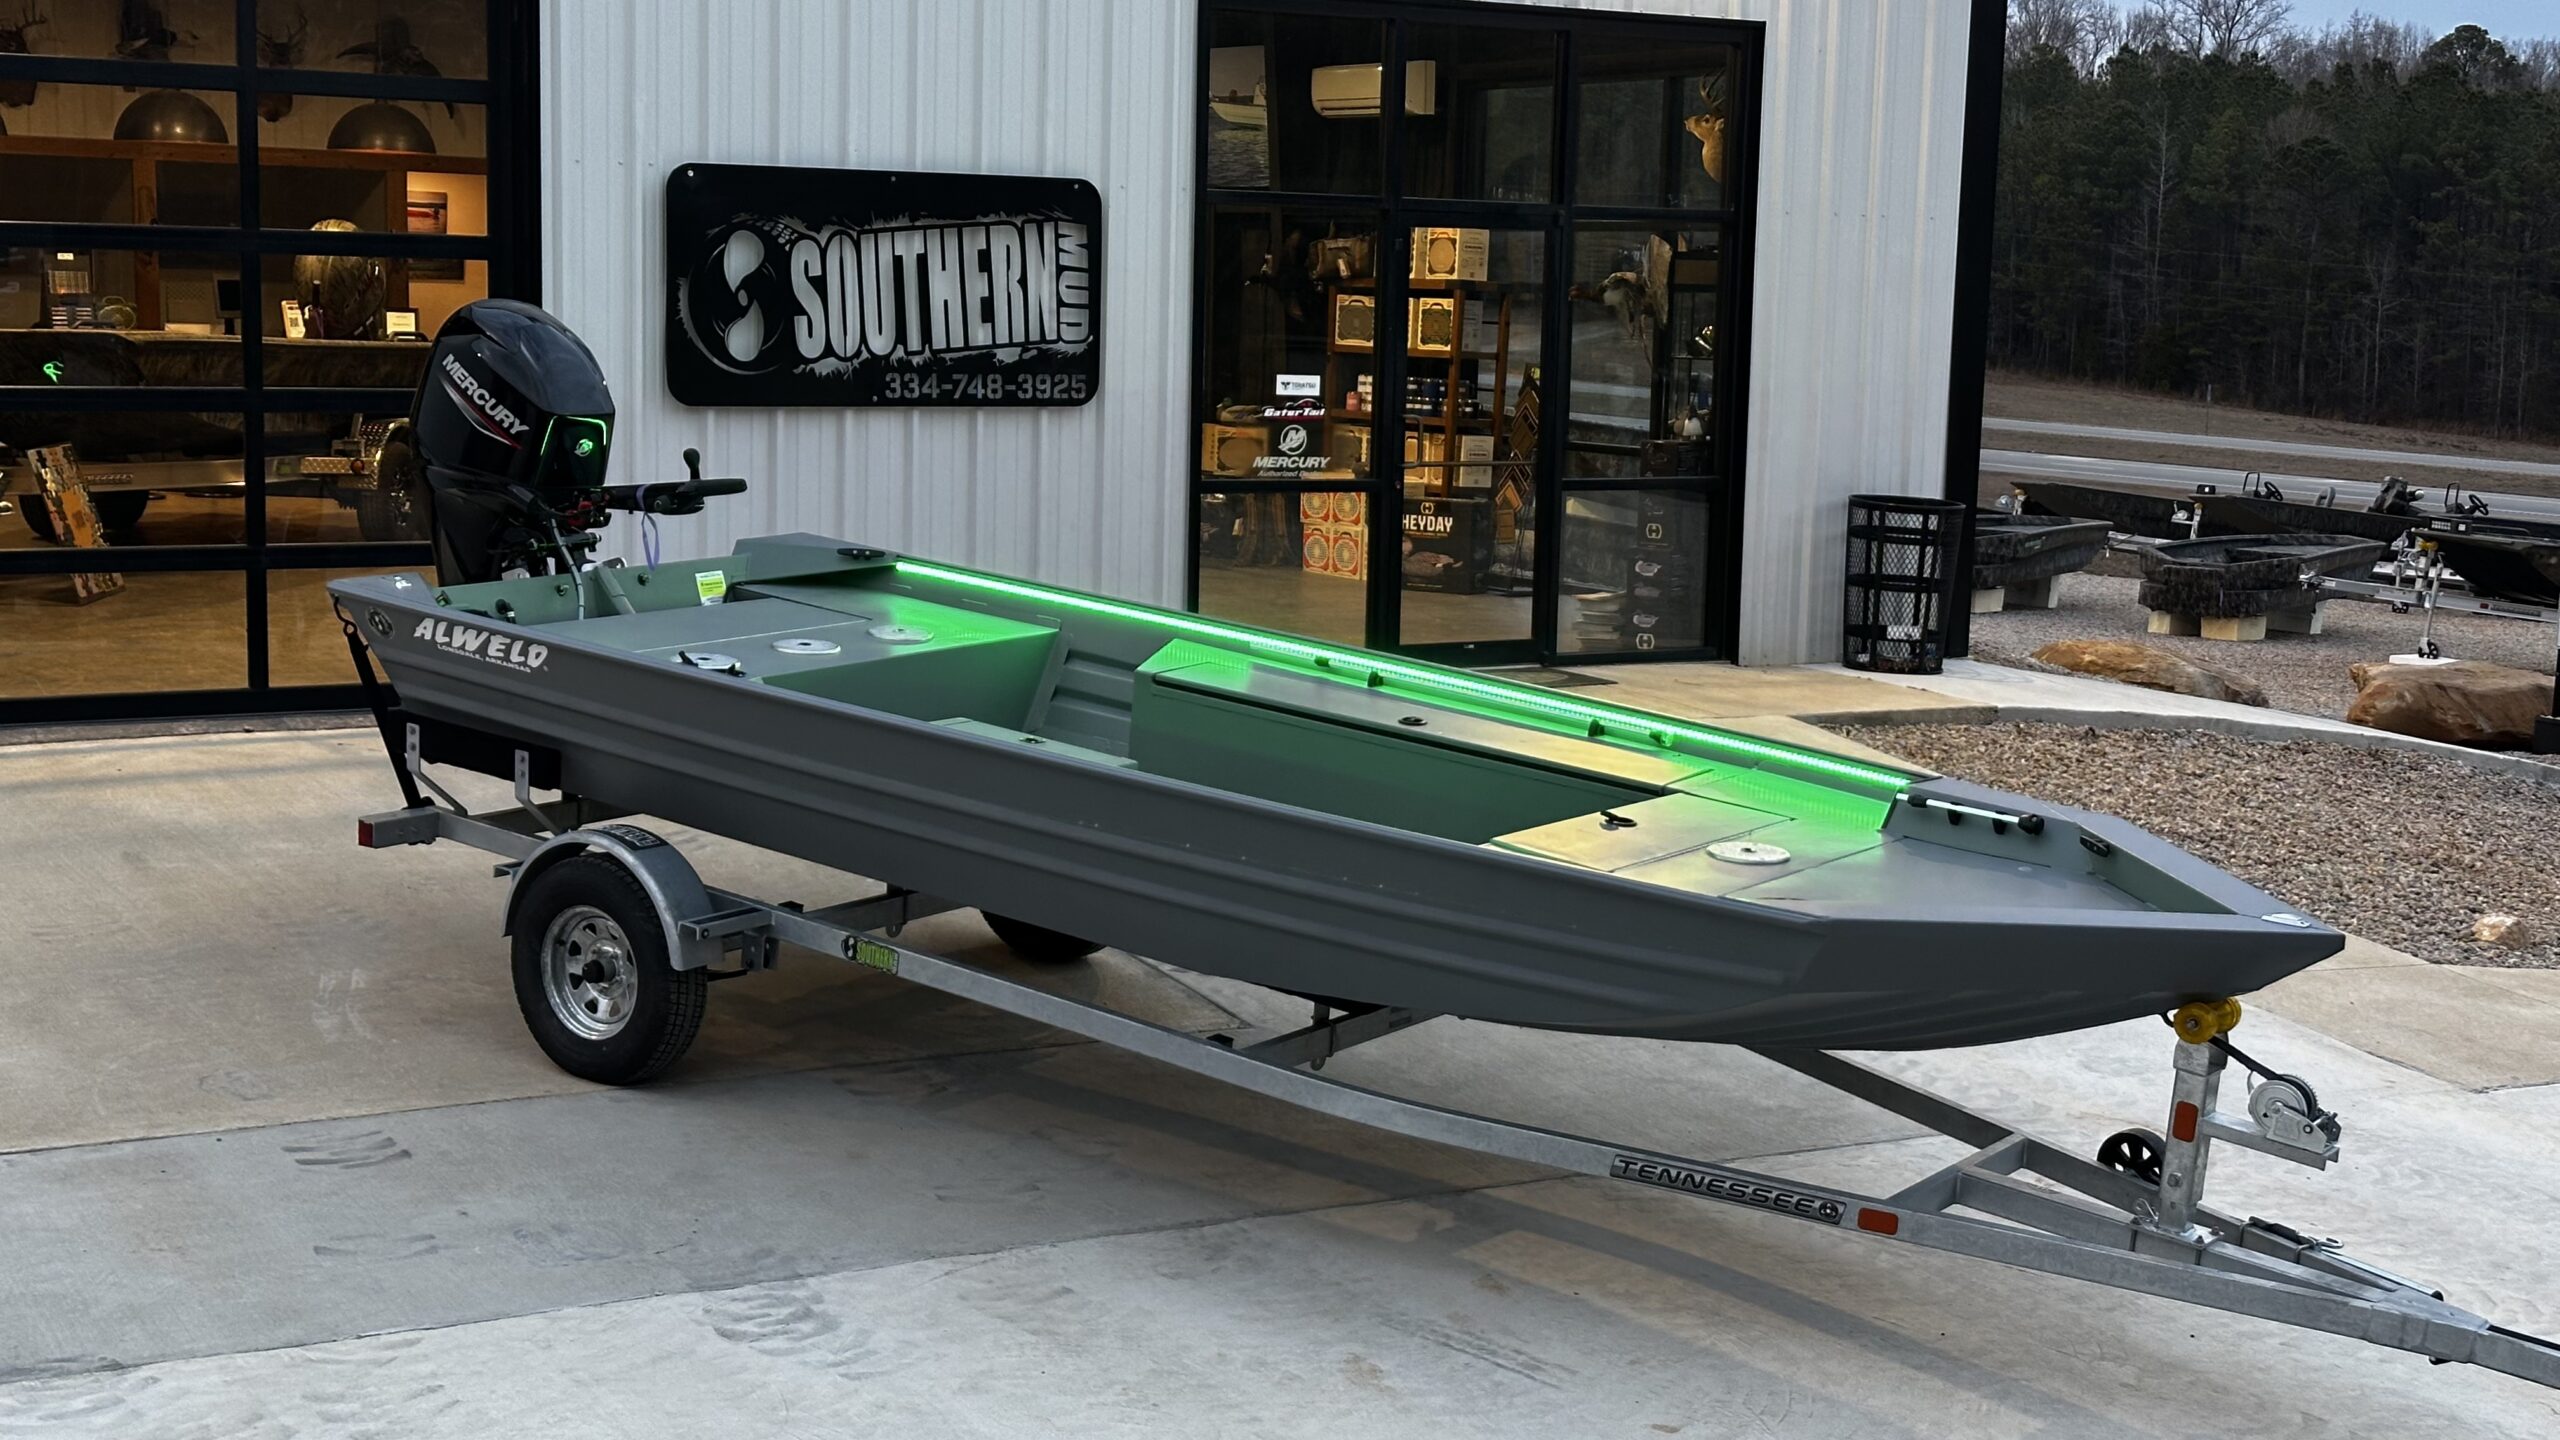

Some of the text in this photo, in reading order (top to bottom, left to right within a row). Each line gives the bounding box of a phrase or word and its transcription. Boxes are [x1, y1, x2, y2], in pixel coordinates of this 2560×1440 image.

[791, 221, 1057, 360] SOUTHERN
[1057, 221, 1089, 342] MUD
[442, 353, 530, 435] MERCURY
[885, 373, 1087, 399] 334-748-3925
[1253, 456, 1331, 468] MERCURY
[1403, 514, 1453, 532] HEYDAY
[413, 617, 548, 668] ALWELD
[1618, 1158, 1815, 1214] TENNESSEE
